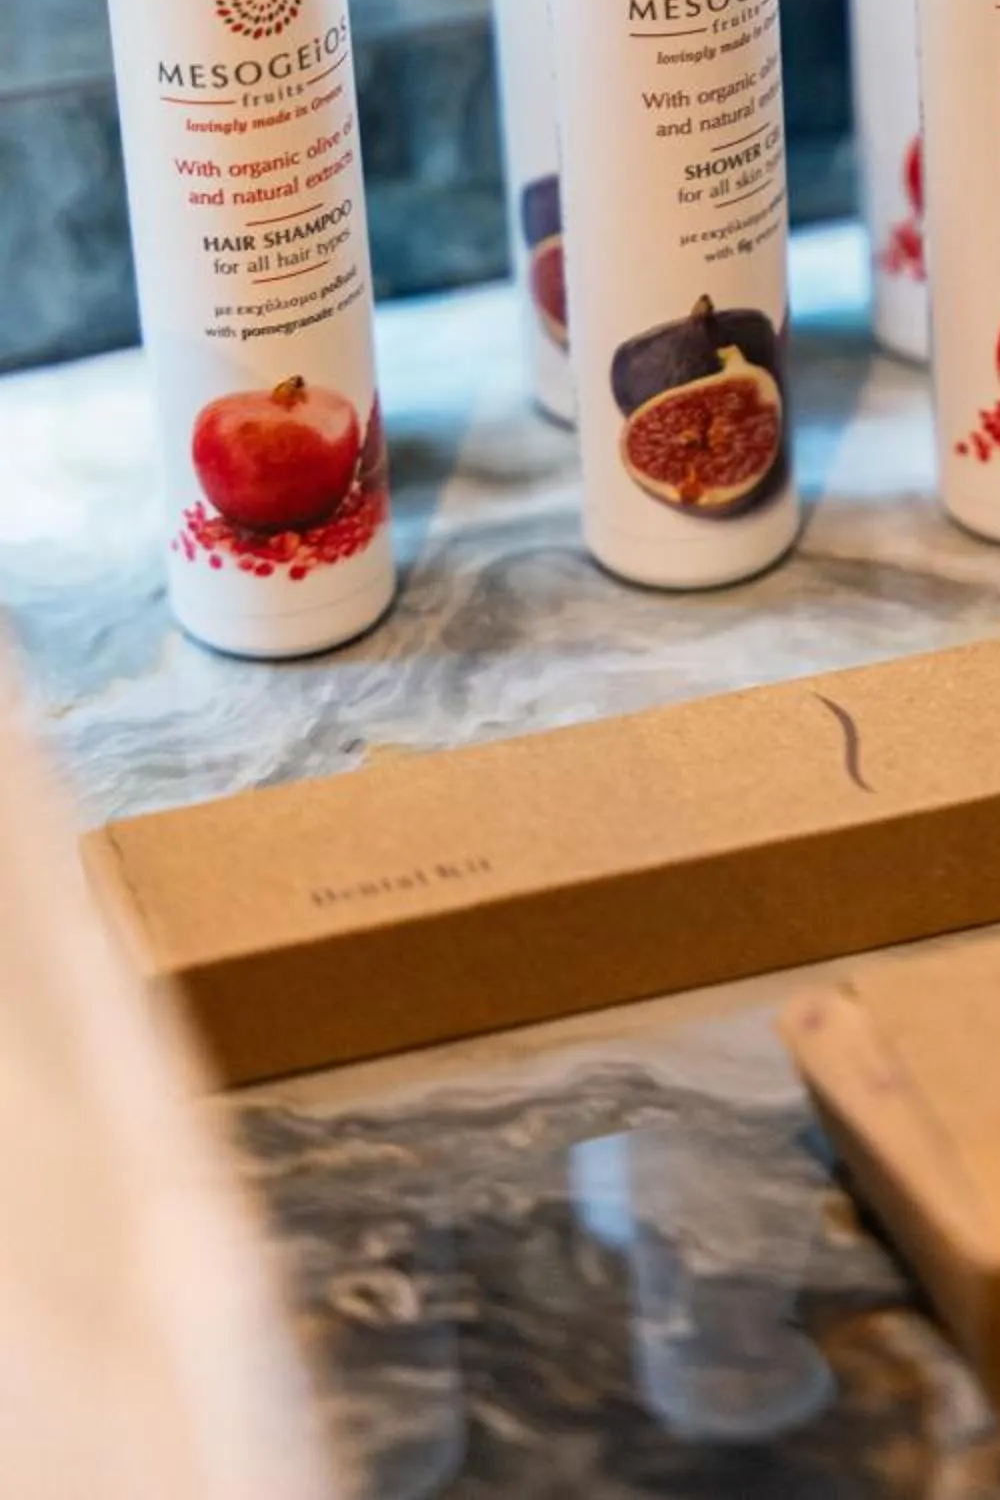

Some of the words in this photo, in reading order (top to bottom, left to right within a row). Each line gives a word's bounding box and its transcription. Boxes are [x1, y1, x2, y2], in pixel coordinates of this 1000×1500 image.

[242, 85, 305, 107] fruits
[642, 90, 690, 110] With
[698, 71, 757, 105] organic
[186, 119, 247, 135] lovingly
[656, 117, 691, 137] and
[700, 96, 754, 132] natural
[175, 158, 221, 177] With
[229, 152, 300, 178] organic
[684, 143, 761, 181] SHOWER
[189, 189, 224, 205] and
[233, 177, 299, 204] natural
[678, 188, 704, 204] for
[709, 179, 729, 199] all
[203, 236, 255, 251] HAIR
[263, 199, 352, 248] SHAMPOO
[213, 259, 238, 275] for
[247, 257, 270, 273] all
[277, 250, 311, 268] hair
